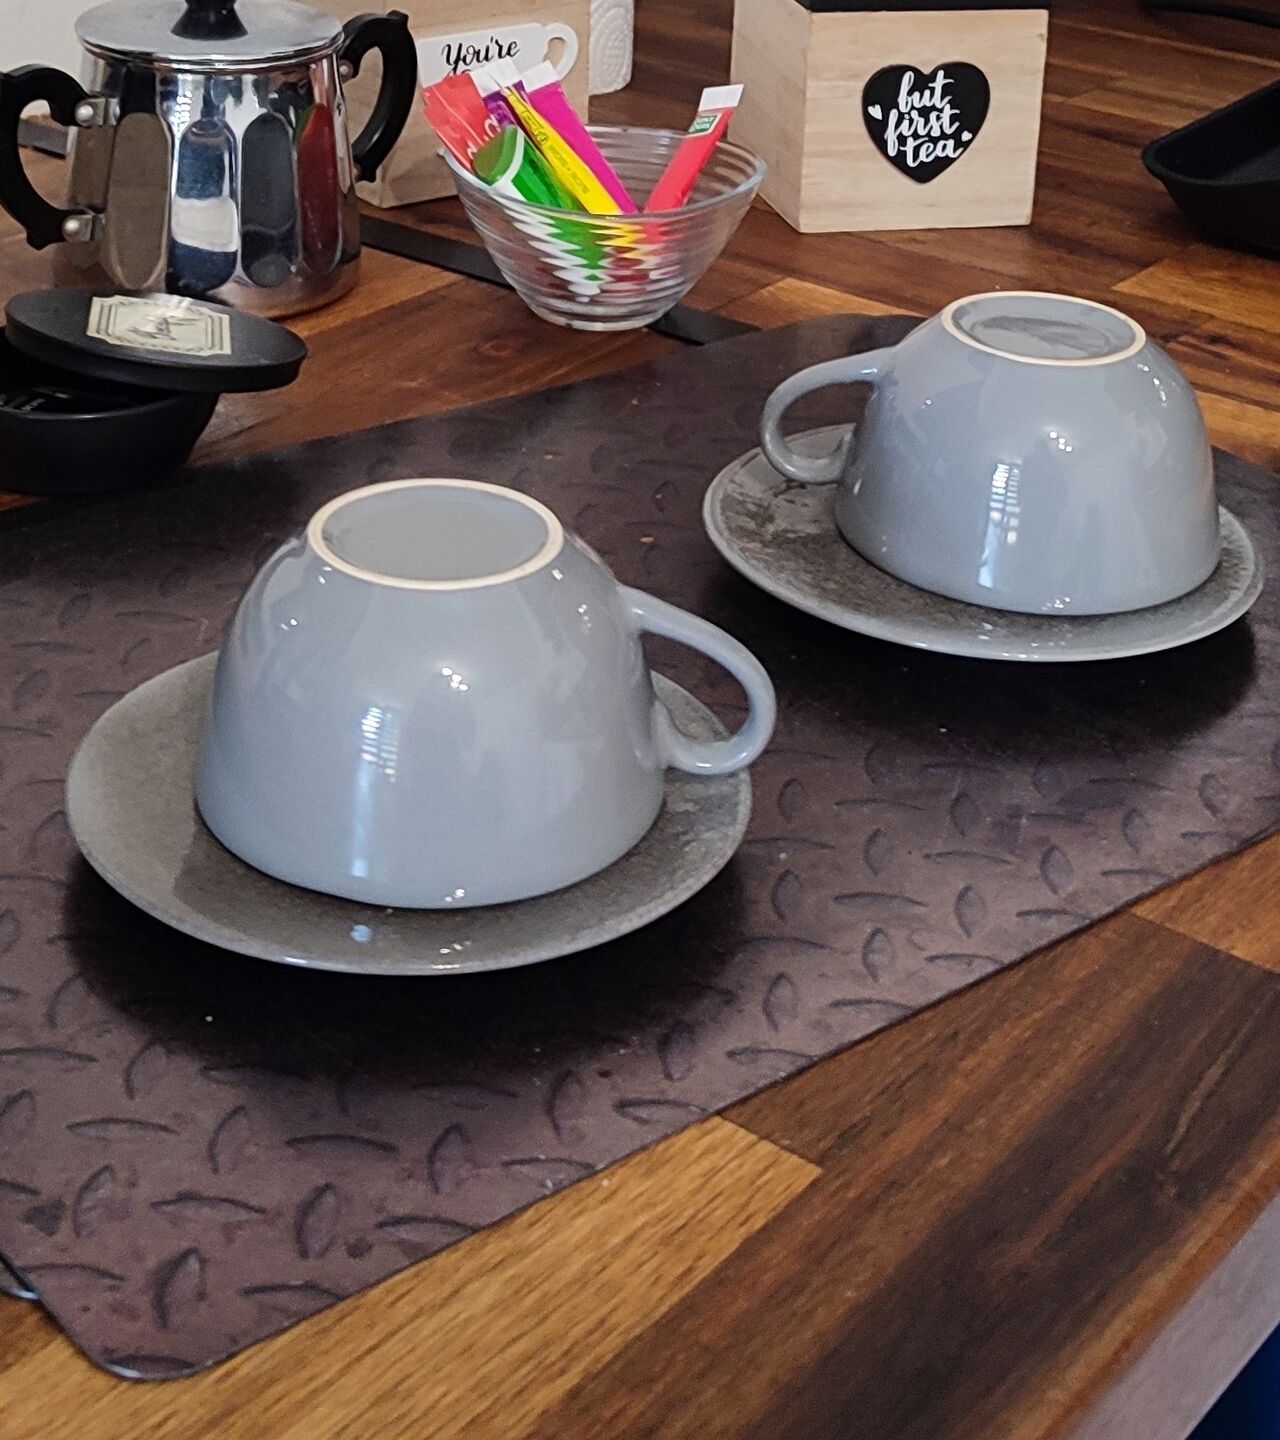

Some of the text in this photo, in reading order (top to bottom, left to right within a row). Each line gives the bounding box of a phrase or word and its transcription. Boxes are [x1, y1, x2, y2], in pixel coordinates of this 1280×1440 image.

[441, 35, 521, 76] You're
[897, 69, 955, 113] but
[883, 103, 961, 157] first
[898, 136, 964, 168] tea
